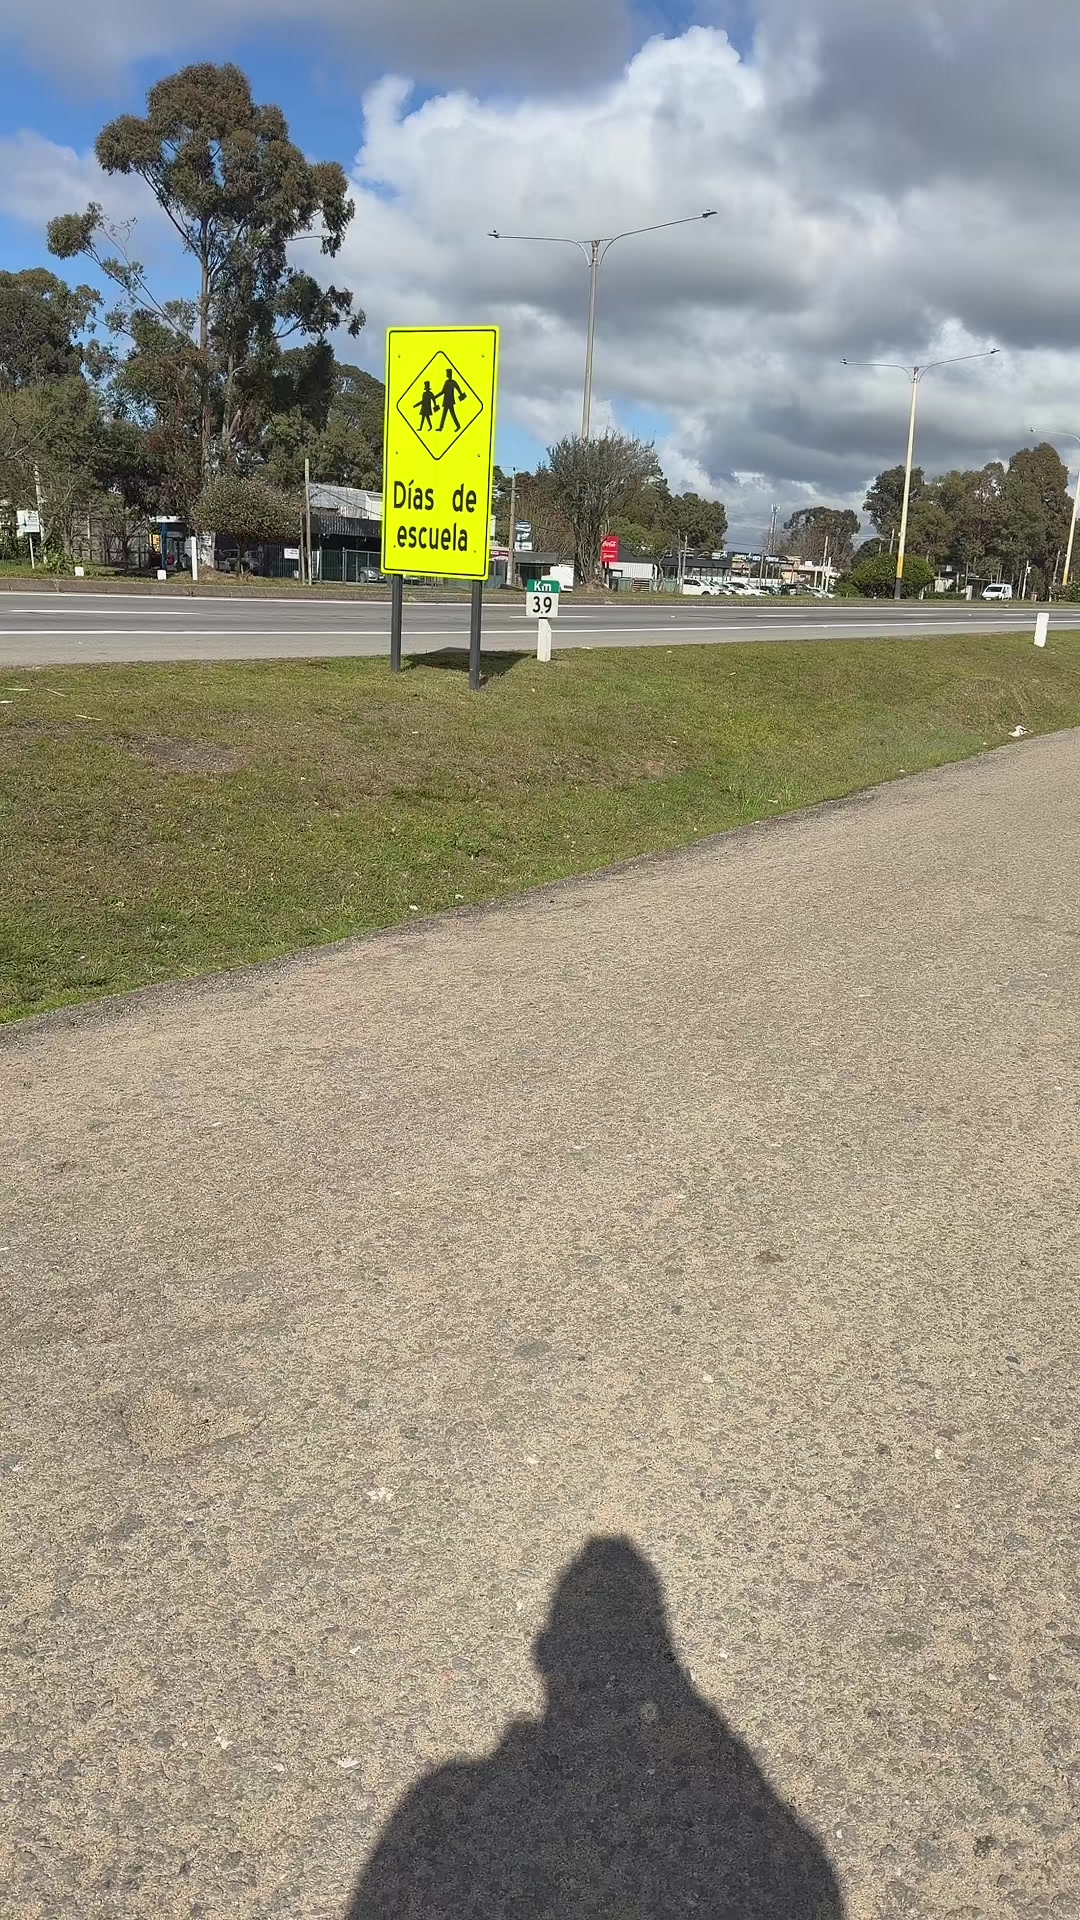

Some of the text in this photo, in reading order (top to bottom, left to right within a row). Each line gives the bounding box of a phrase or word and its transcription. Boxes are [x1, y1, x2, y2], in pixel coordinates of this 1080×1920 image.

[393, 479, 477, 513] Días de
[397, 522, 468, 552] escuela
[534, 580, 552, 592] Km
[532, 596, 552, 614] 3.9
